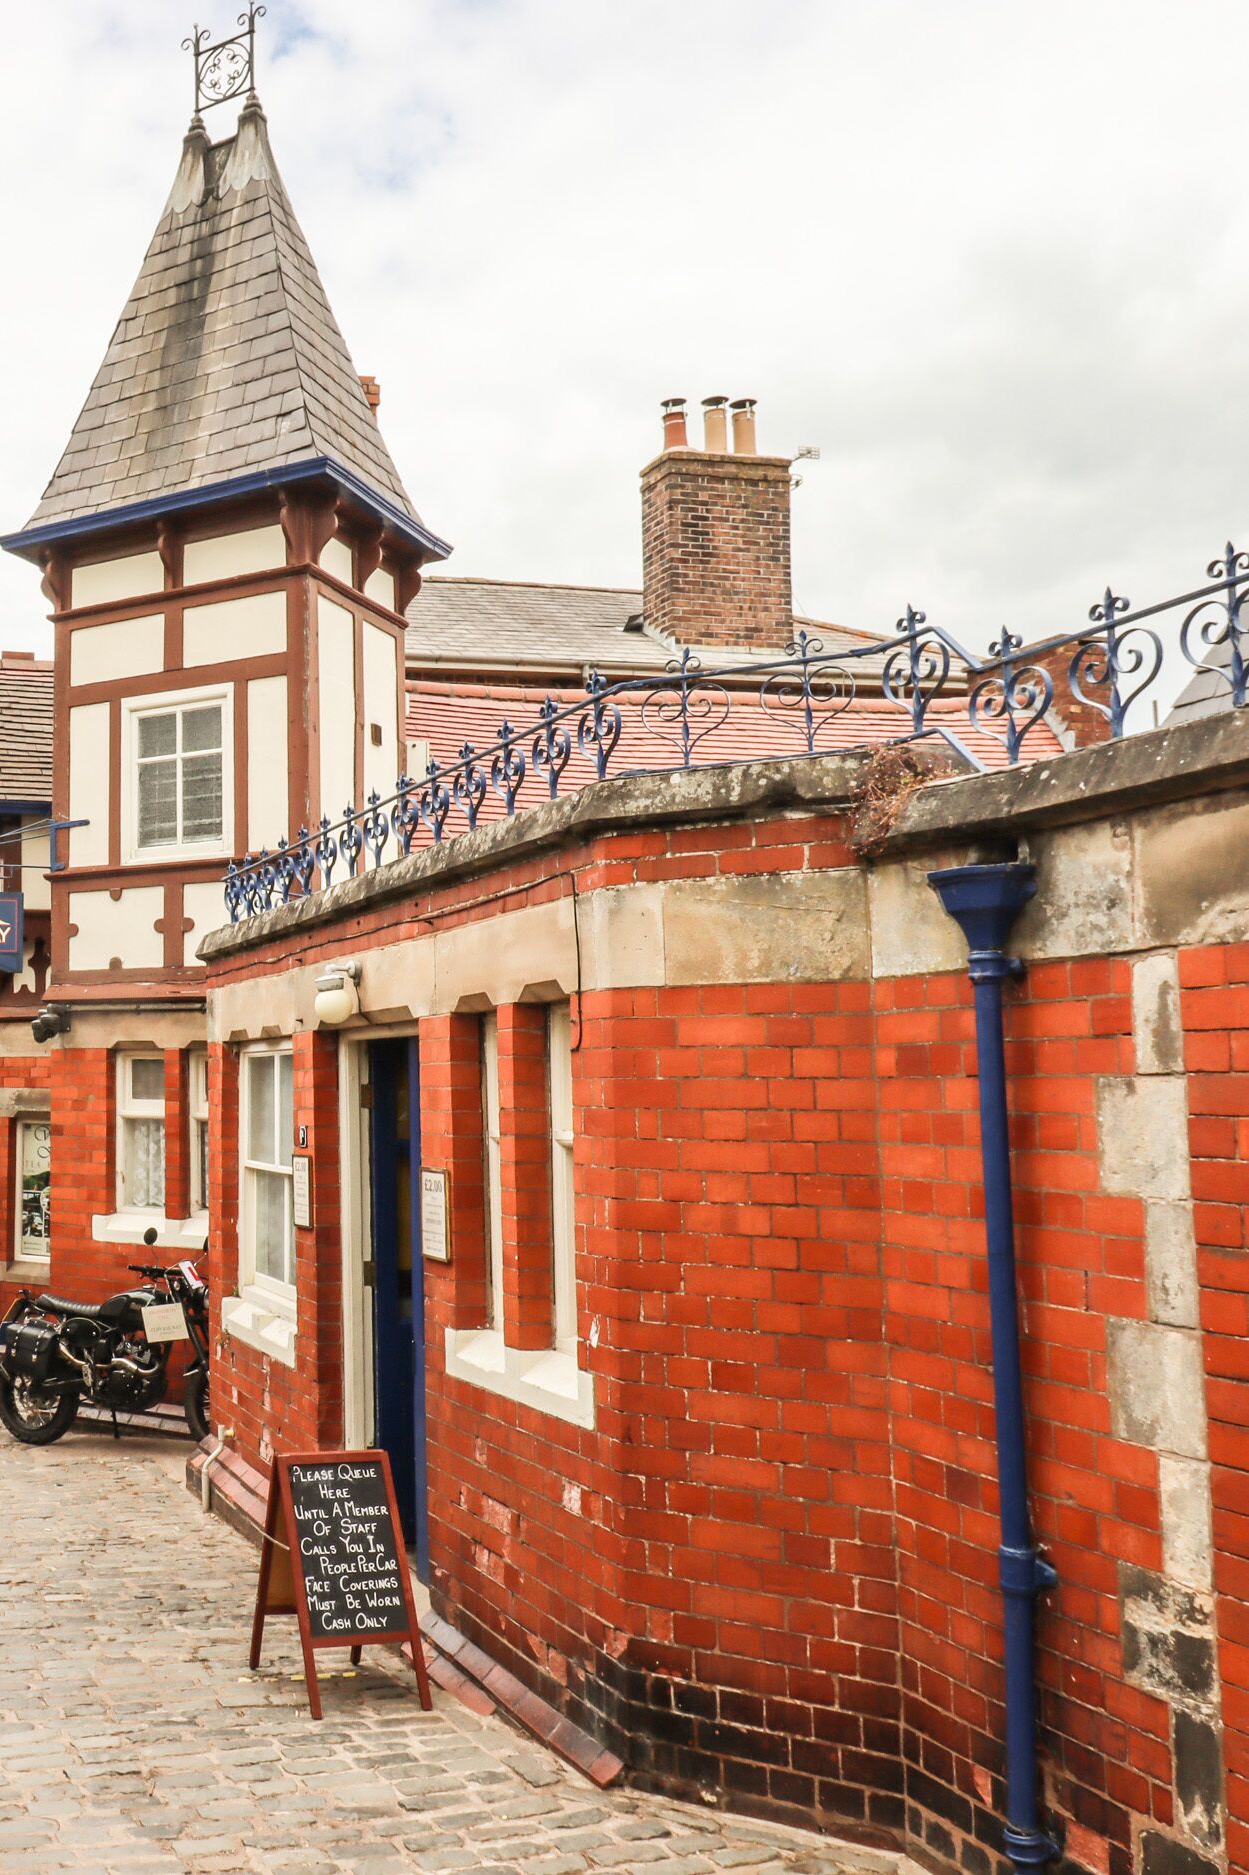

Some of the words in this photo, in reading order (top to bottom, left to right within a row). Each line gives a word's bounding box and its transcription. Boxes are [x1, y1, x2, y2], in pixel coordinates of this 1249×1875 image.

[425, 1179, 442, 1193] £2.00
[292, 1465, 334, 1482] PLEASE
[338, 1463, 377, 1481] QUEUE
[318, 1484, 351, 1499] HERE
[294, 1505, 329, 1520] UNTIL
[332, 1501, 342, 1517] A
[344, 1501, 388, 1517] MEMBER
[313, 1520, 332, 1536] OF
[340, 1518, 377, 1535] STAFF
[300, 1537, 337, 1555] CALLS
[339, 1536, 363, 1553] YOU
[367, 1535, 385, 1553] IN
[320, 1556, 356, 1576] PEOPLE
[357, 1555, 376, 1573] PER
[376, 1553, 397, 1571] CAR
[305, 1576, 330, 1594] FACE
[339, 1575, 398, 1592] COVERINGS
[307, 1595, 336, 1611] MUST
[345, 1594, 361, 1609] BE
[365, 1592, 400, 1608] WORN
[321, 1612, 351, 1630] CASH
[355, 1612, 388, 1629] ONLY
